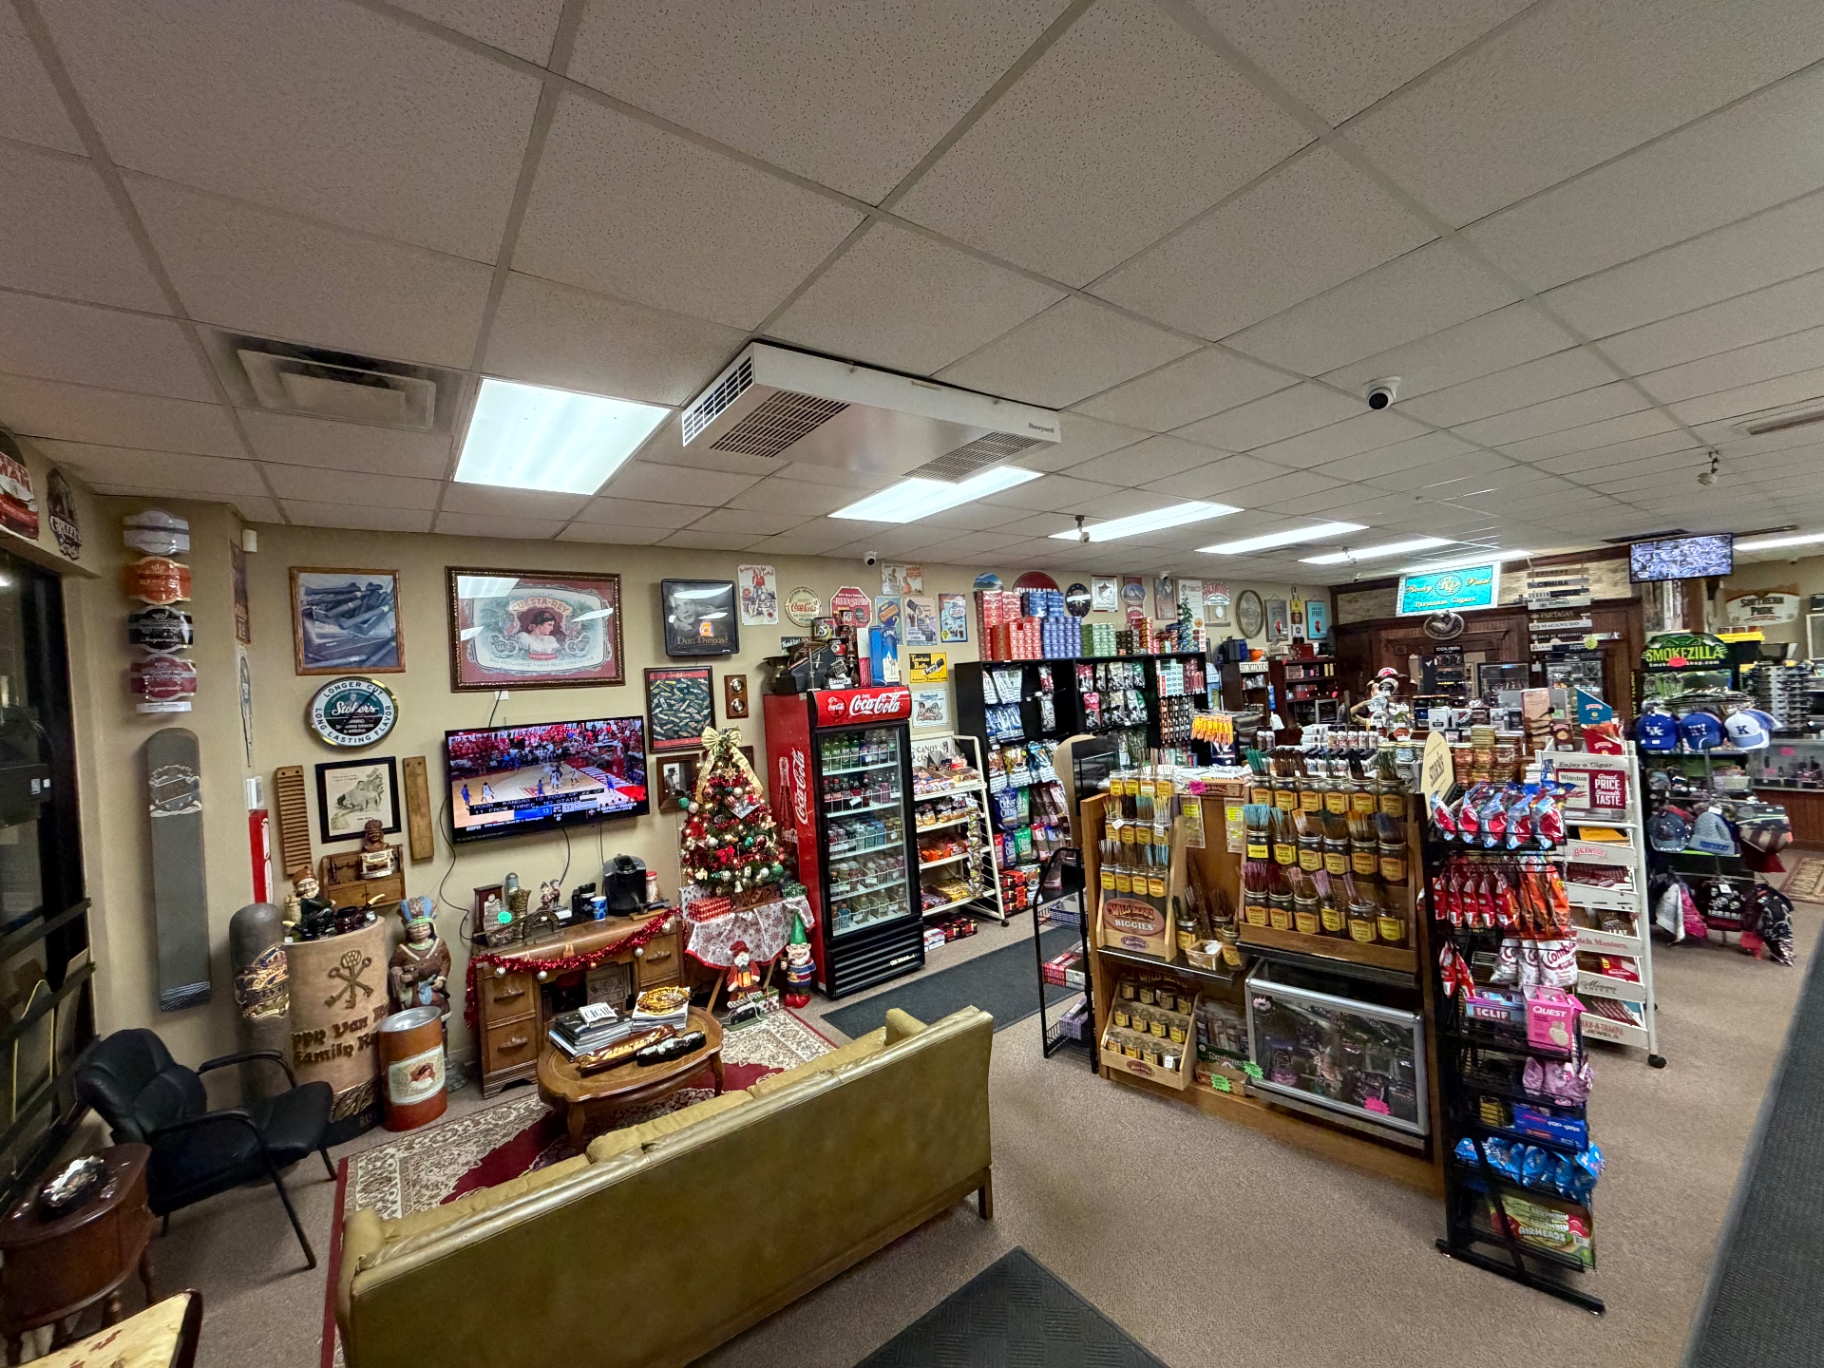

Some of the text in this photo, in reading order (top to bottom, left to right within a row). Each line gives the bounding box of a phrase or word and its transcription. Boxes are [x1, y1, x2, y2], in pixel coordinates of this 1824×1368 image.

[1028, 422, 1054, 433] Honeywell
[1537, 580, 1569, 588] COHIBA
[1540, 610, 1575, 619] PARTAGAS
[677, 635, 697, 645] Don
[1646, 645, 1724, 663] SMOKEZILLA
[323, 681, 385, 698] LONGER CUT
[849, 692, 901, 716] Coca-Cola
[315, 708, 328, 731] LONG
[327, 731, 372, 744] LASTING
[373, 705, 392, 736] FLAVOR
[1735, 724, 1749, 735] K
[916, 744, 939, 754] CANDY
[1560, 774, 1588, 782] Winston
[791, 746, 808, 825] Coca-Cola
[1594, 778, 1620, 791] PRICE
[1594, 794, 1622, 806] TASTE
[1115, 919, 1154, 931] BIGGIES
[584, 1005, 613, 1019] CIGAR
[1532, 1005, 1568, 1018] QUEST
[1585, 1027, 1619, 1039] JEWELS
[1518, 1225, 1567, 1242] AIRHEADS
